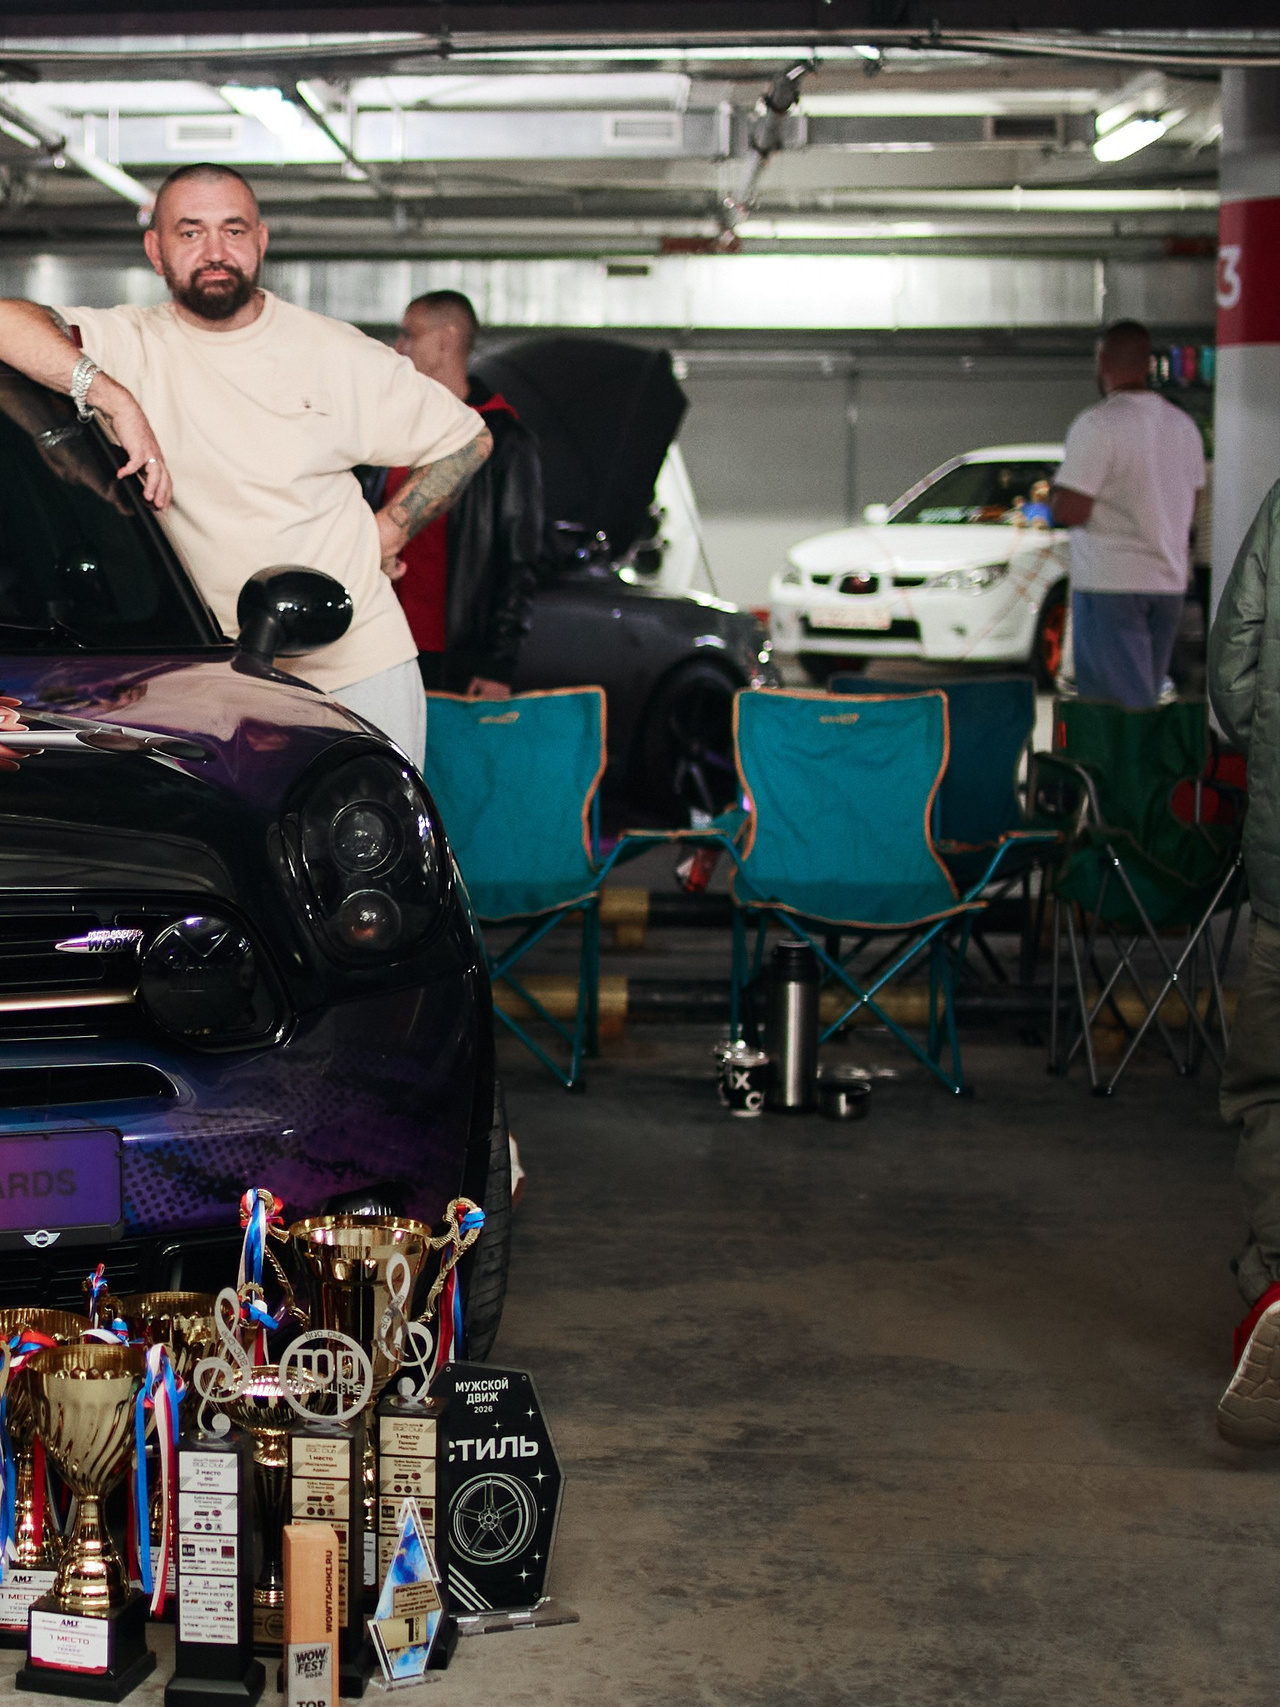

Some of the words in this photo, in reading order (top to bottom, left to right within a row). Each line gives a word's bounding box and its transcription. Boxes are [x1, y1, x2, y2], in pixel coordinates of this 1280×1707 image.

[455, 1377, 509, 1392] МУЖСКОЙ
[466, 1392, 499, 1405] ДВИЖ
[473, 1405, 493, 1413] 2026
[404, 1617, 414, 1642] 1
[56, 1635, 90, 1645] МЕСТО
[296, 1648, 326, 1663] WOW
[297, 1660, 325, 1674] FEST
